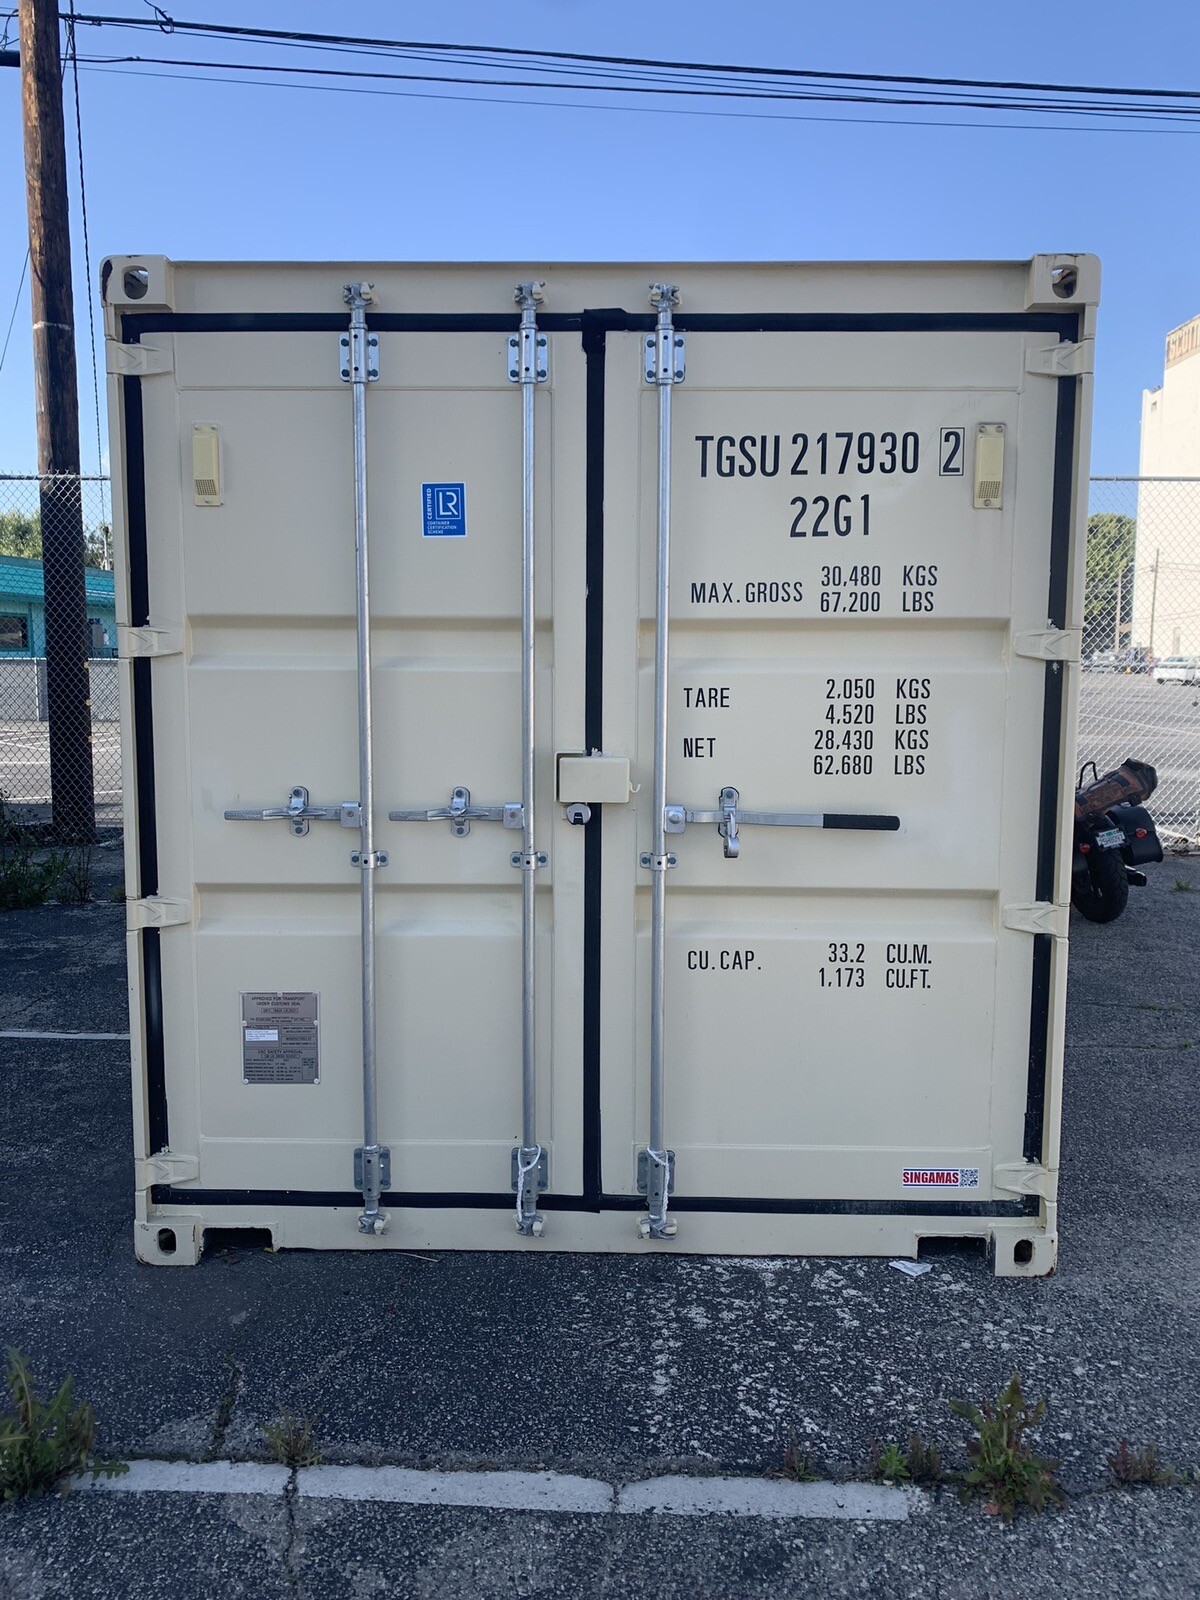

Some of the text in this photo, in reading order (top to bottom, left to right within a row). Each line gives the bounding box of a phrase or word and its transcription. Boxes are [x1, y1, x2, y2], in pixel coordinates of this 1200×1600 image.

[695, 431, 960, 477] TGSU 217930 2
[439, 492, 458, 515] LR
[790, 494, 869, 537] 22G1
[822, 565, 937, 587] 30,480 KGS
[821, 591, 933, 612] 67,200 LBS
[684, 688, 729, 707] TARE
[826, 679, 930, 699] 2,050 KGS
[826, 704, 926, 724] 4,520 LBS
[684, 738, 716, 758] NET
[814, 730, 928, 750] 28,430 KGS
[814, 755, 925, 775] 62,680 LBS
[829, 943, 931, 964] 33.2 CU.M.
[819, 968, 930, 988] 1,173 CU.FT.
[903, 1172, 959, 1183] SINGAMAS
